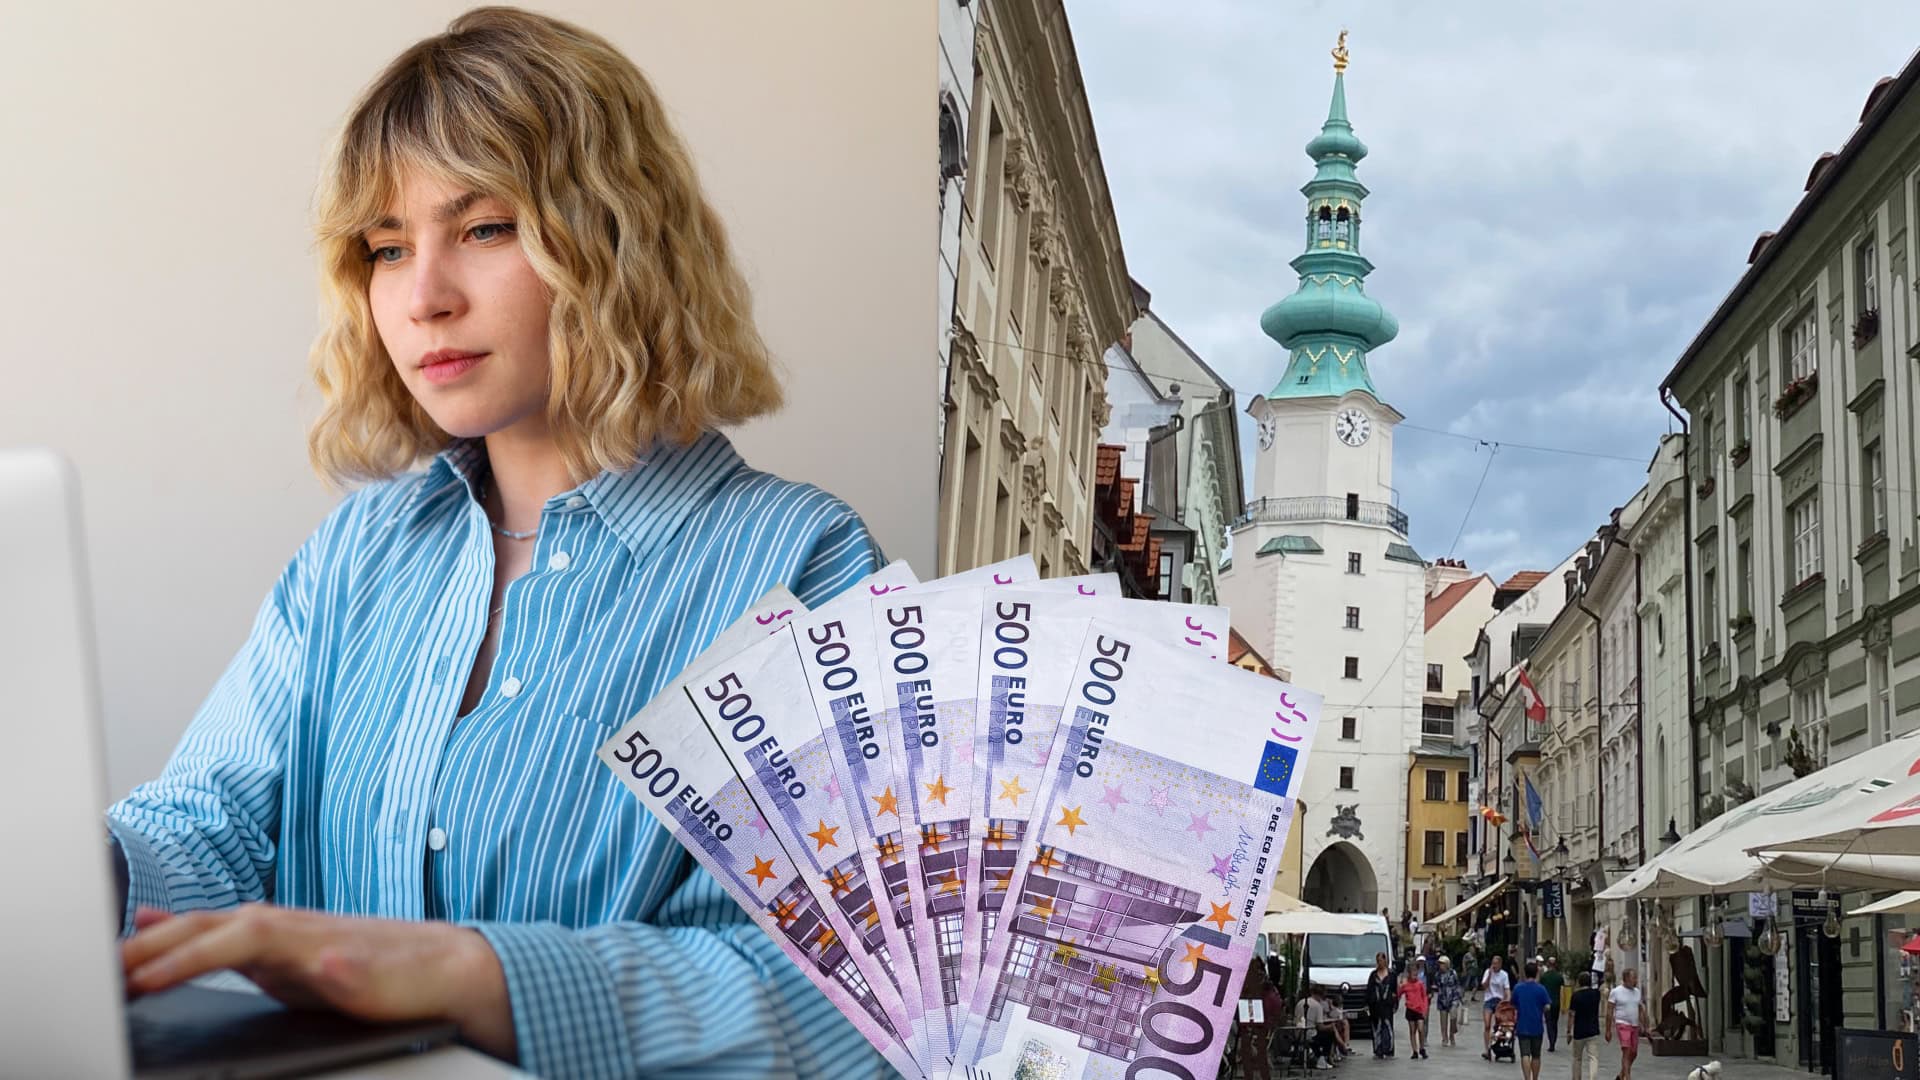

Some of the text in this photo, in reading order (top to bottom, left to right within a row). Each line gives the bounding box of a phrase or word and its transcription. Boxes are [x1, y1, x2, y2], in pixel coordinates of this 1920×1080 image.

[808, 621, 879, 759] 500 EURO
[887, 606, 938, 747] 500 EURO
[994, 602, 1030, 744] 500 EURO
[705, 673, 805, 799] 500 EURO
[1077, 635, 1130, 777] 500 EURO
[614, 731, 733, 841] 500 EURO
[1261, 835, 1274, 855] ECB
[1268, 813, 1280, 833] BCE
[1250, 877, 1262, 898] EKT
[1255, 856, 1268, 875] EZB
[1238, 919, 1249, 938] 2002
[1244, 898, 1256, 918] EKP
